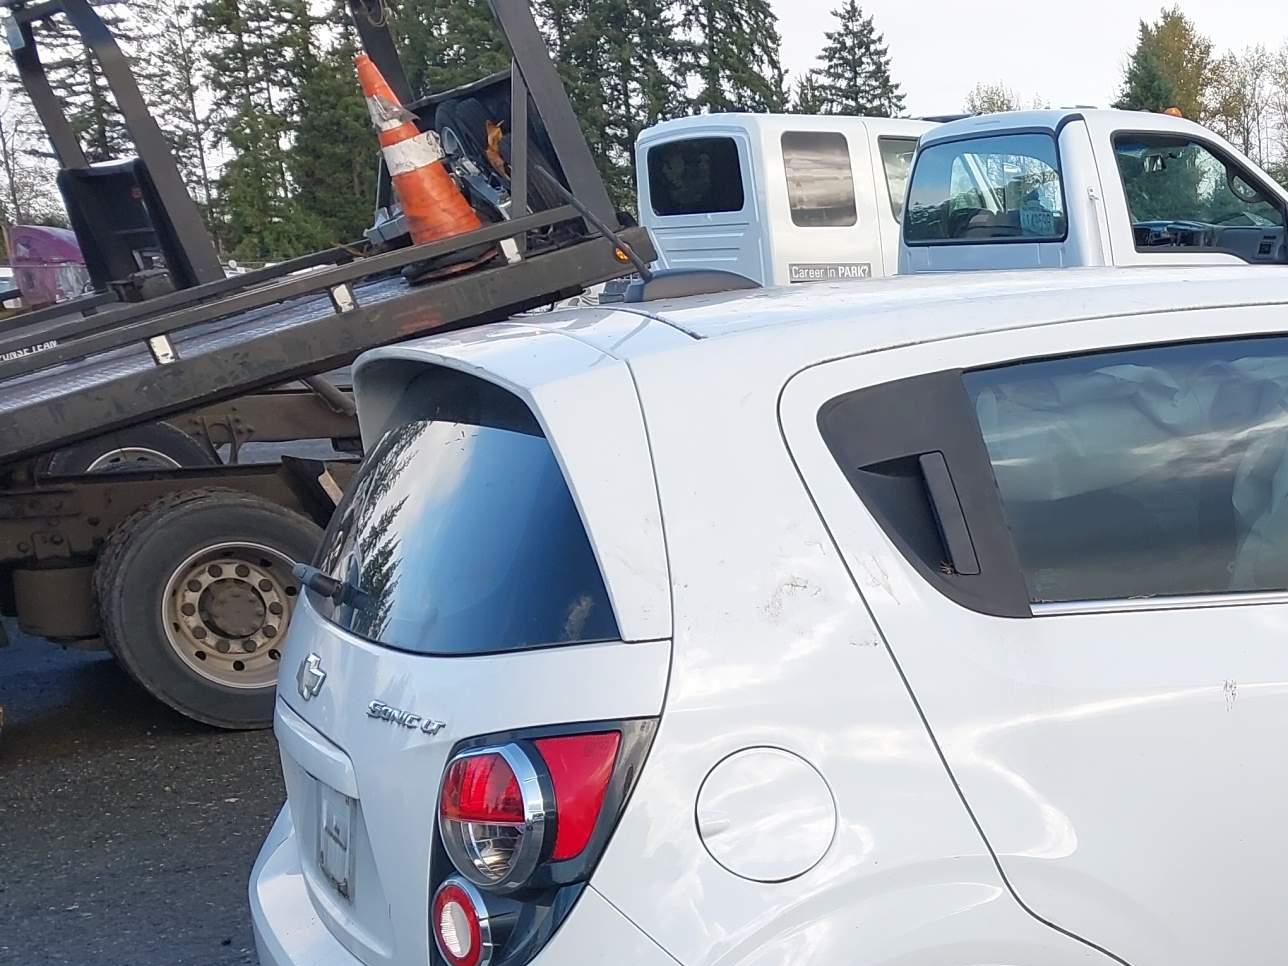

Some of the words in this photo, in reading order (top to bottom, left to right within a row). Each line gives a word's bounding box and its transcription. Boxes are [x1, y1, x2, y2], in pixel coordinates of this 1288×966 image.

[792, 266, 825, 278] Career
[827, 266, 837, 278] in
[838, 265, 869, 278] PARK?
[366, 700, 421, 729] SONIC
[421, 719, 446, 735] LT
